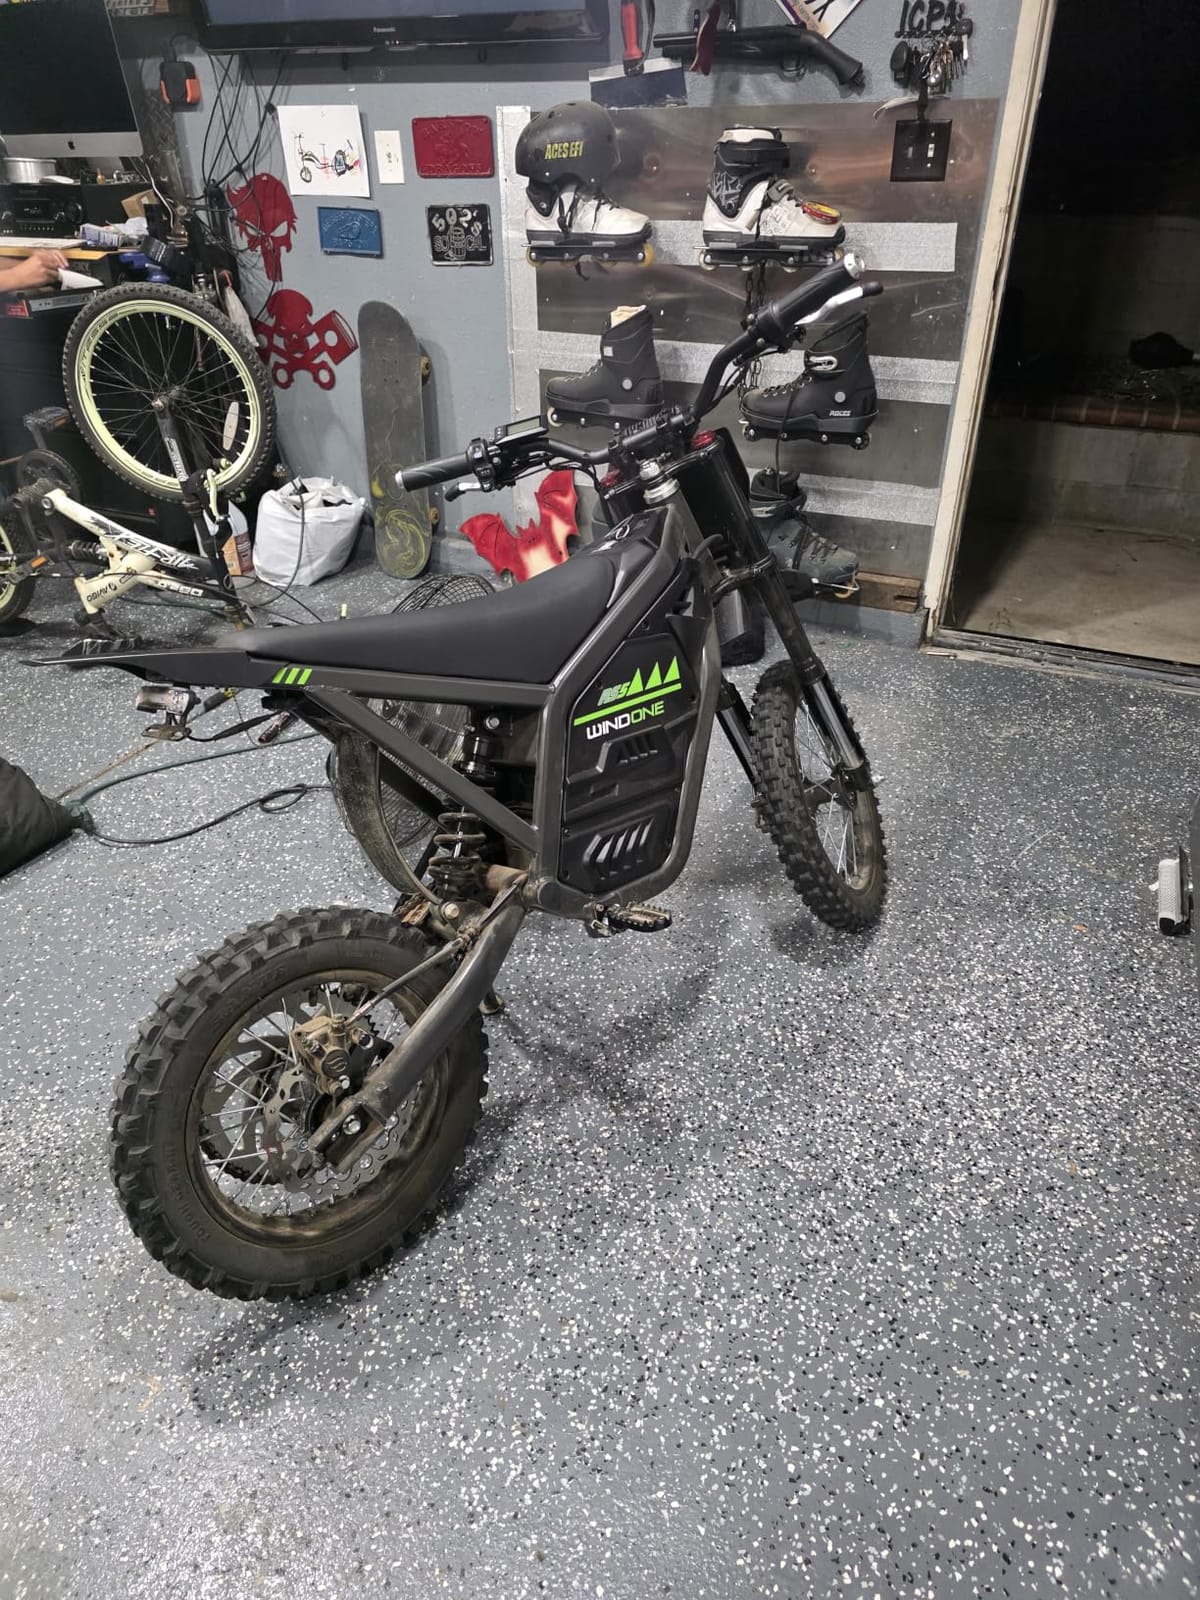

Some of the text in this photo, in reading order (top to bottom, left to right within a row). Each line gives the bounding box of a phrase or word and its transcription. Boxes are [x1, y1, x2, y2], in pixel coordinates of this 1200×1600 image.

[544, 141, 584, 160] ACES EFI
[586, 701, 665, 740] WINDONE
